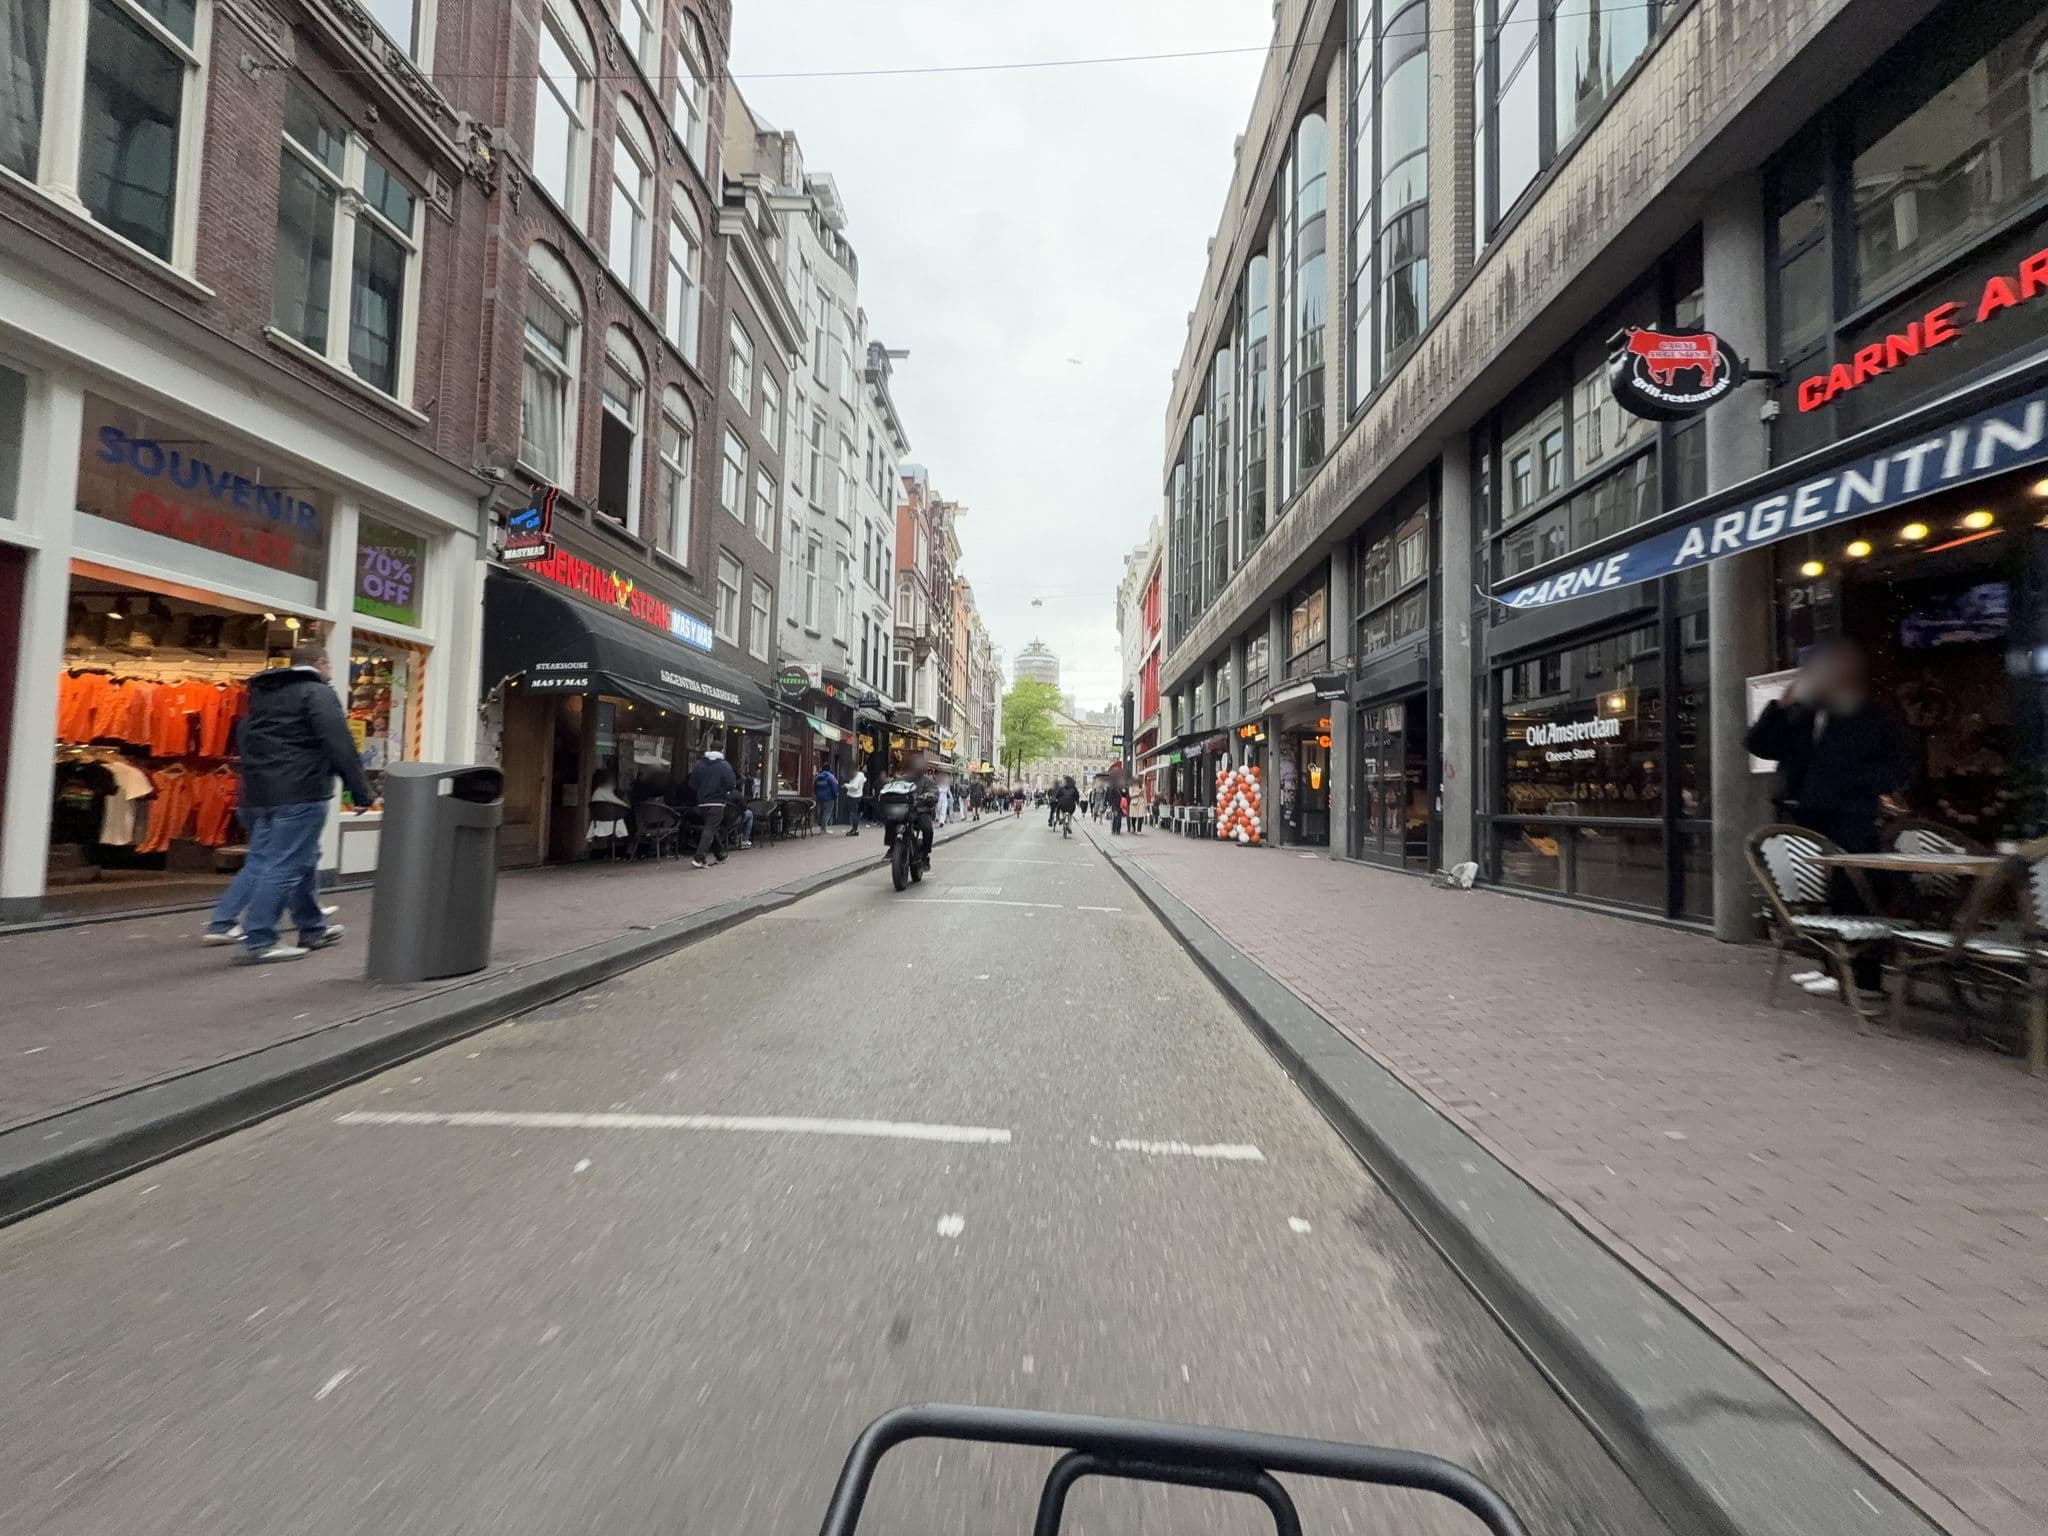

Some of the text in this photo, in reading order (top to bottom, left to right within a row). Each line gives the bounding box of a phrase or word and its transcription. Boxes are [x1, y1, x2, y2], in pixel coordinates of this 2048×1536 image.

[1799, 302, 1961, 413] CARNE
[97, 425, 319, 535] SOUVENIR
[1510, 400, 2047, 607] CARNE ARGENTIN
[129, 492, 294, 568] OUTLET
[358, 544, 412, 584] 70%
[522, 549, 618, 605] GENTINA
[363, 574, 409, 605] OFF
[535, 661, 589, 670] STEAKHOUSE
[660, 669, 701, 692] ARGENTINA
[531, 679, 554, 687] MAS
[564, 678, 588, 686] MAS
[688, 702, 704, 717] MAS
[710, 708, 725, 721] MAS
[1526, 716, 1620, 746] Old Amsterdam
[1545, 748, 1596, 762] Cheese Store
